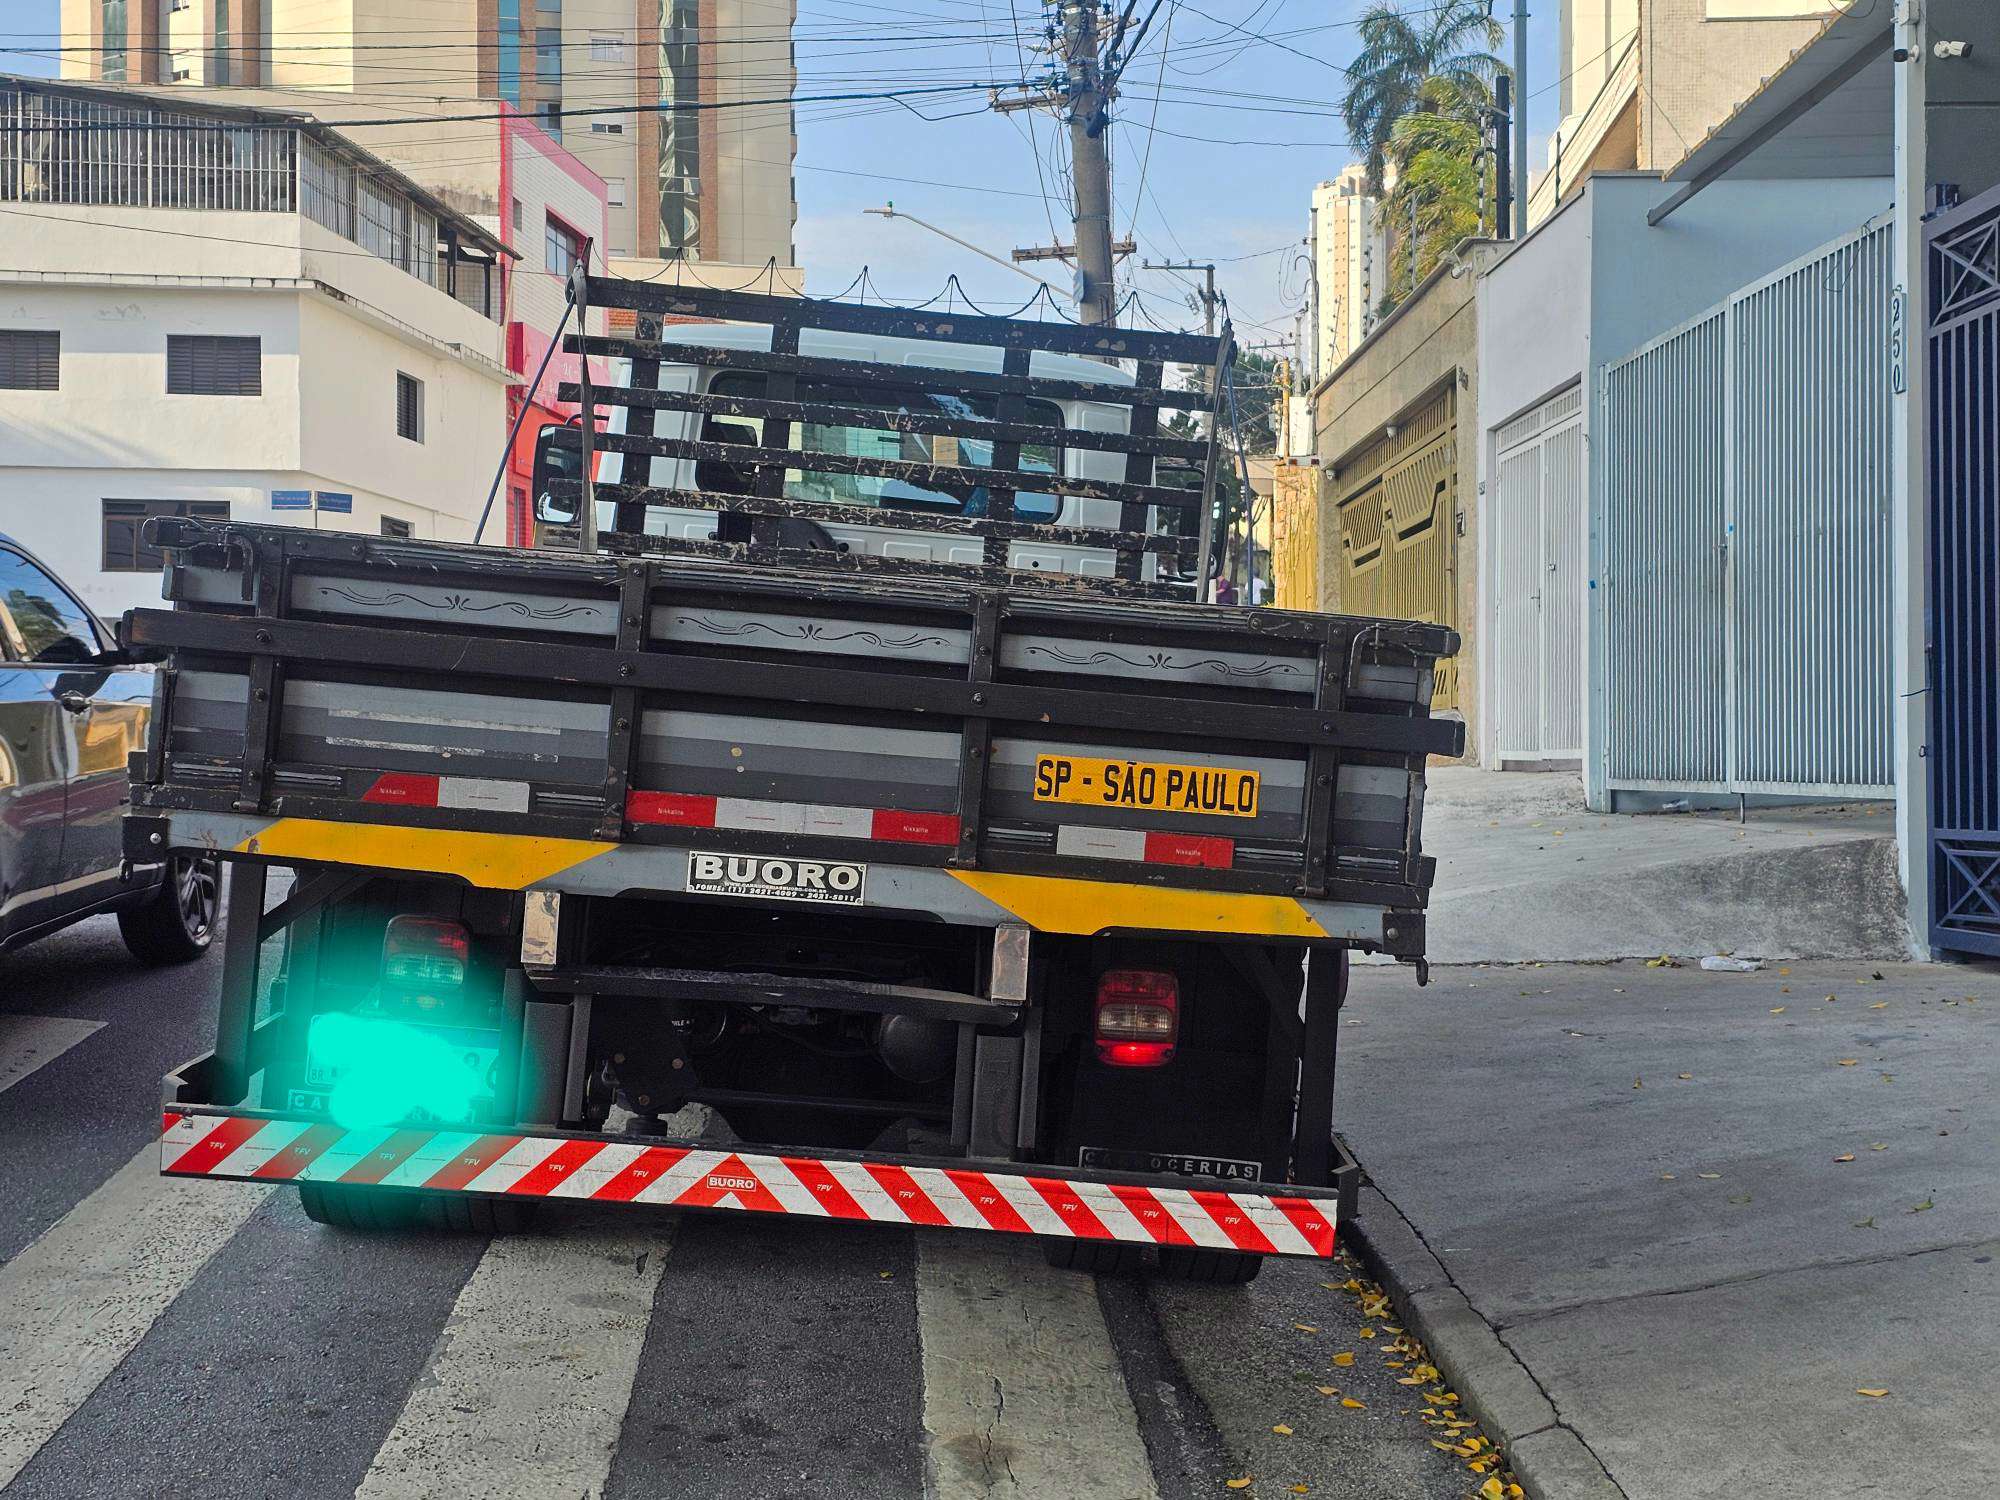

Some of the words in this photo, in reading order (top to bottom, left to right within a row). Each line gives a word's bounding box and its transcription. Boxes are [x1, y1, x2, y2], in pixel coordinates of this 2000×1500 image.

[1036, 759, 1072, 798] SP
[1102, 760, 1156, 805] SÃO
[1165, 769, 1255, 813] PAULO
[695, 855, 860, 891] BUORO
[1085, 1152, 1255, 1178] COCERIAS
[709, 1176, 755, 1189] BUORO
